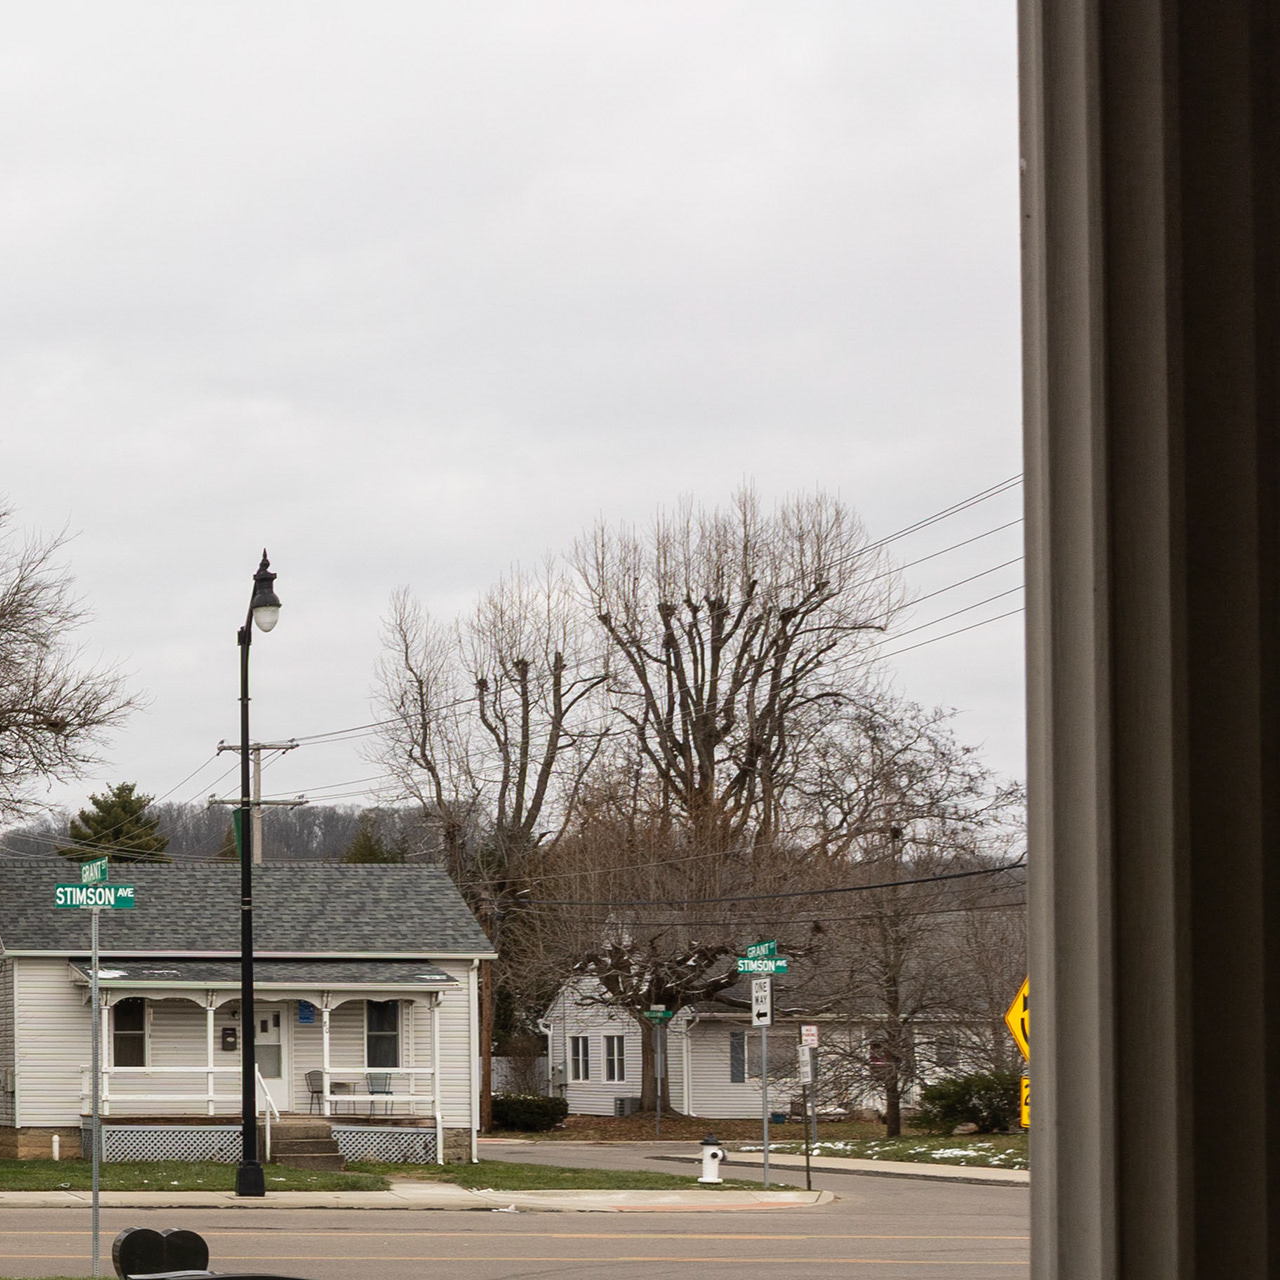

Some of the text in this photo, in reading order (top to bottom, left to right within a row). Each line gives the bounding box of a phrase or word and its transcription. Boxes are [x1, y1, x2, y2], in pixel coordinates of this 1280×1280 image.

[81, 861, 102, 883] GRANT
[55, 887, 134, 905] STIMSON AVE
[747, 943, 769, 958] GRANT
[737, 959, 775, 971] STIMSON
[754, 981, 768, 993] ONE
[754, 995, 768, 1006] WAY
